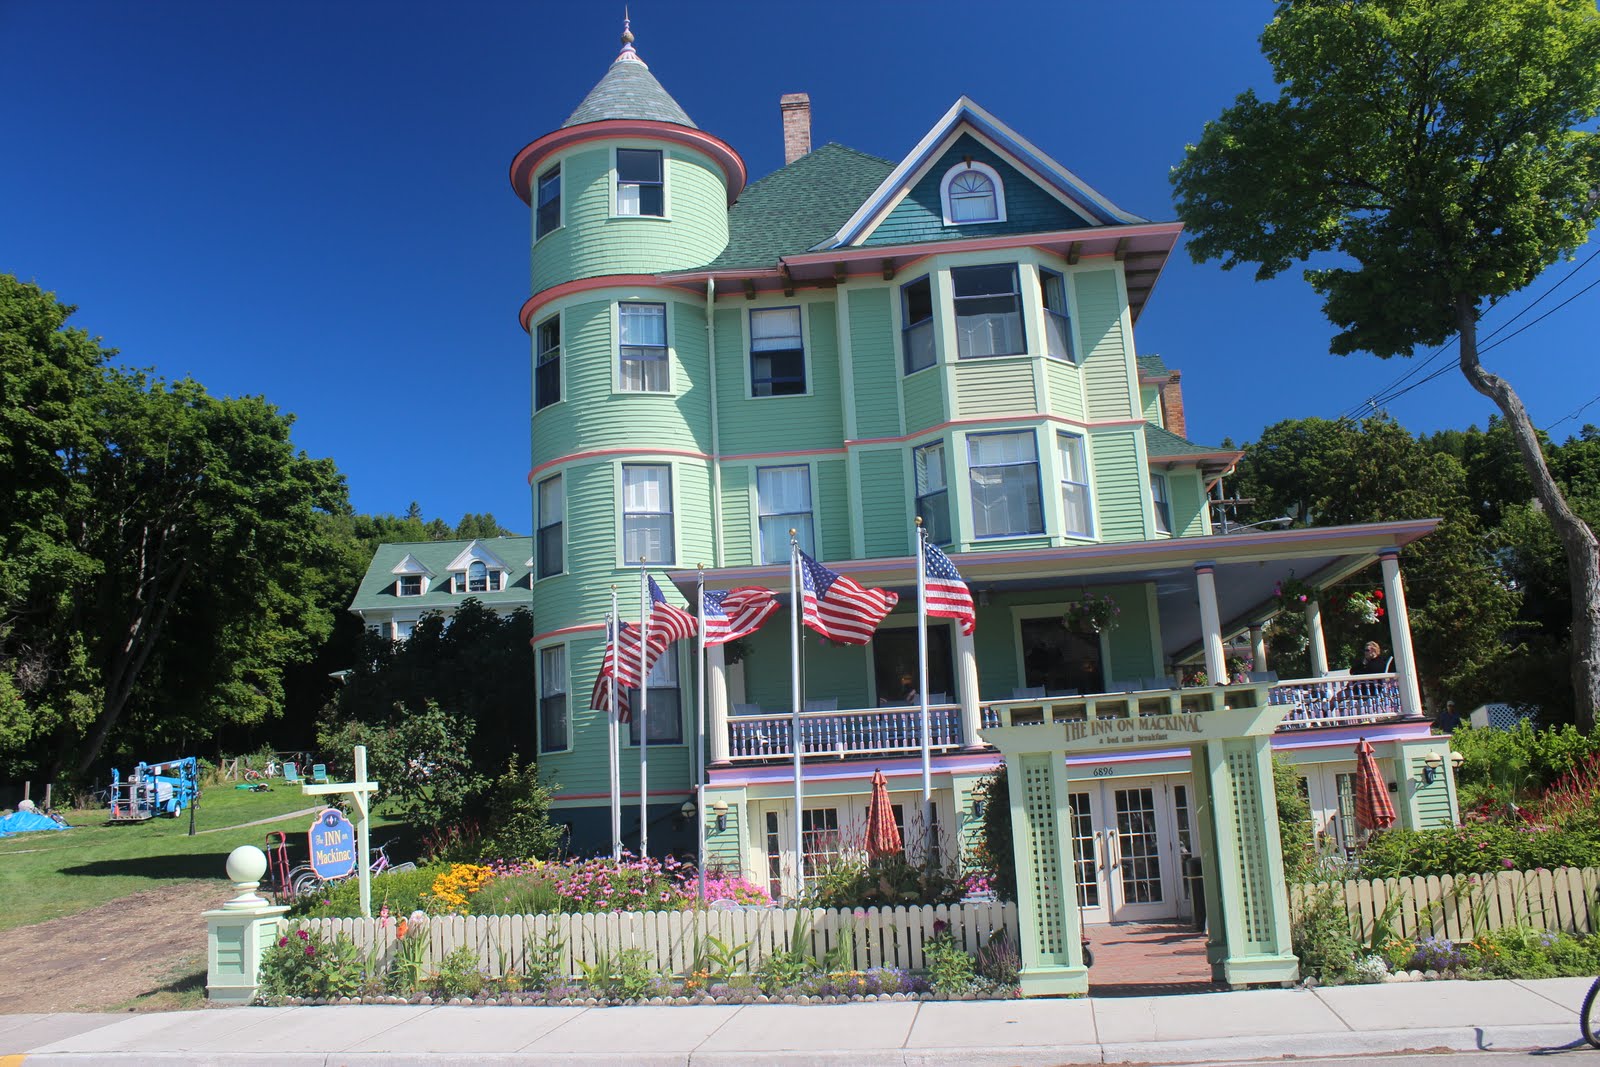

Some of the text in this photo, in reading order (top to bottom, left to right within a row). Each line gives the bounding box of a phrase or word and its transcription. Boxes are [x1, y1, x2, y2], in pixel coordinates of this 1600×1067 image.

[1063, 714, 1204, 742] THE INN ON MACKINAC
[1106, 735, 1119, 744] bed
[1121, 735, 1134, 743] and
[1137, 732, 1168, 742] breakfast
[1093, 767, 1113, 777] 6896
[323, 829, 341, 847] INN
[316, 848, 351, 866] Mackinac
